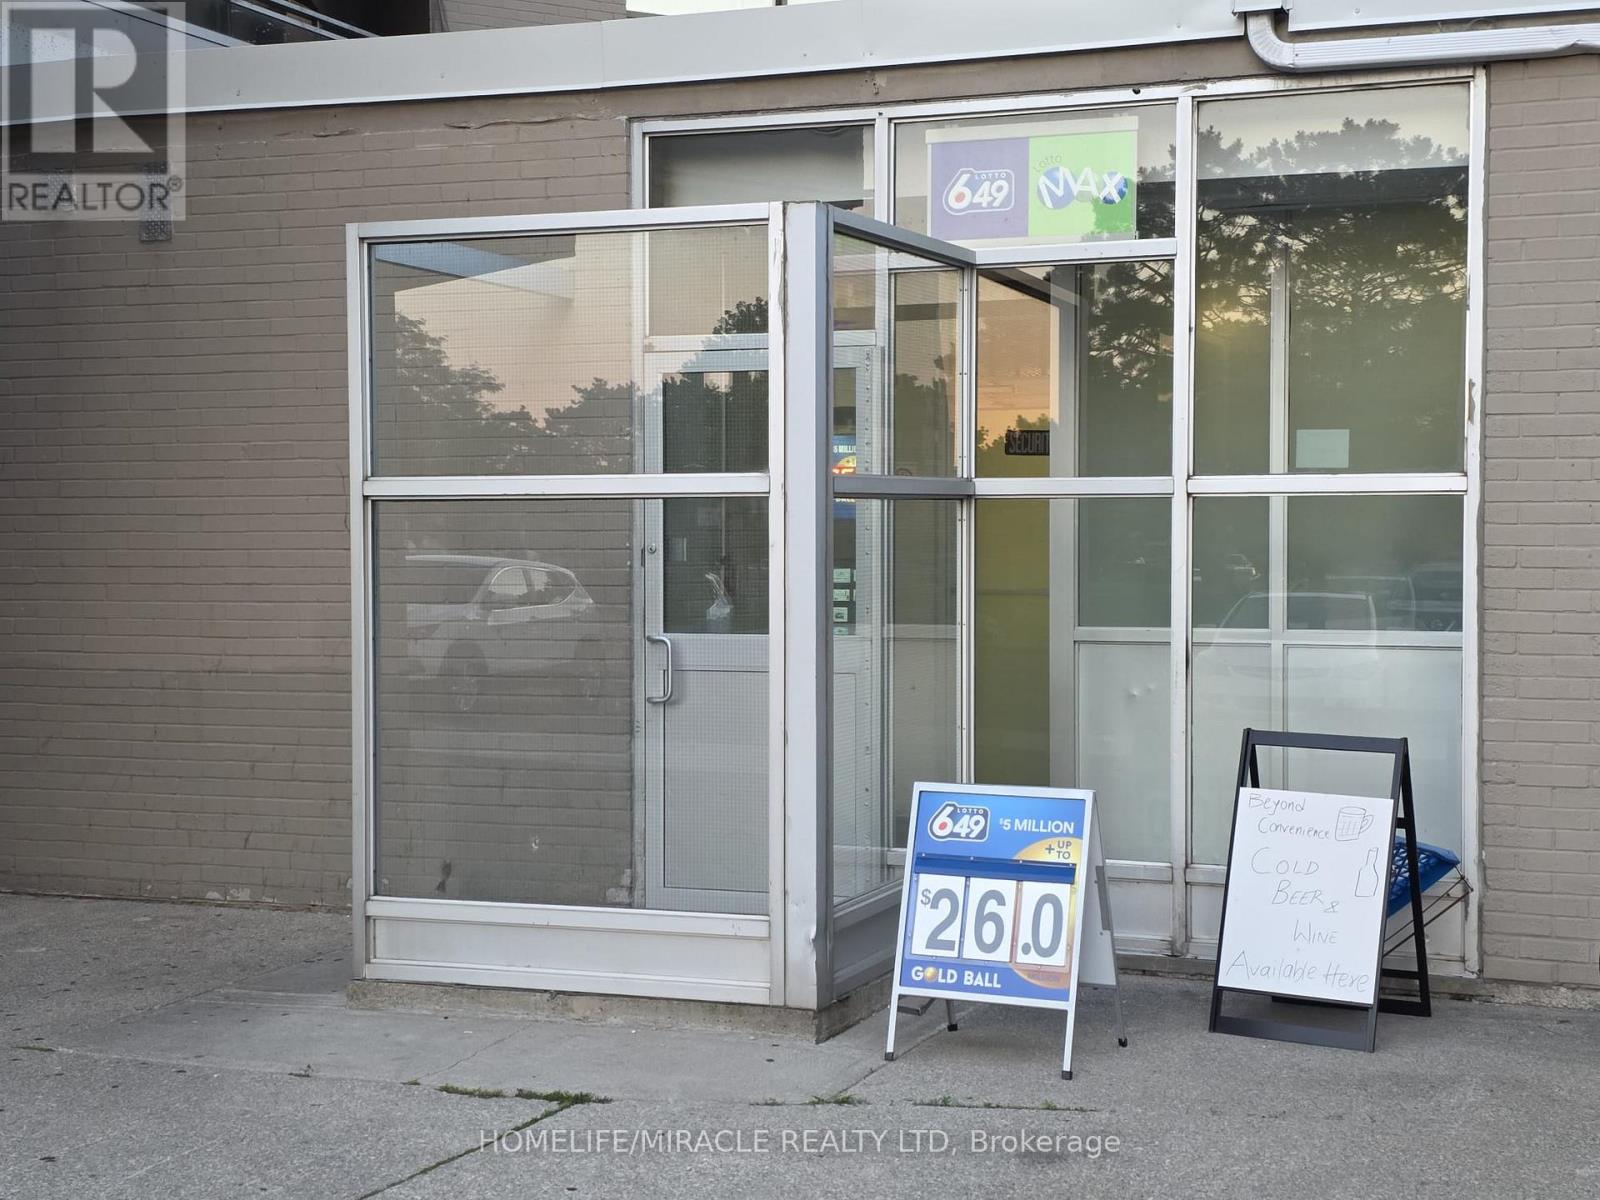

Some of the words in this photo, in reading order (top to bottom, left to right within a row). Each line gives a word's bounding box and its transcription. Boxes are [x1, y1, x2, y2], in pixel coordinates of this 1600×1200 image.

[975, 172, 1007, 180] LOTTO
[949, 173, 1010, 210] 649
[1248, 793, 1306, 815] Beyond
[932, 805, 986, 839] 649
[1014, 819, 1075, 834] MILLION
[1258, 816, 1330, 840] Convenience
[1057, 841, 1072, 850] UP
[1057, 851, 1071, 860] TO
[1251, 847, 1320, 875] COLD
[1271, 879, 1324, 905] BEER
[1323, 900, 1340, 913] &
[1293, 919, 1339, 944] WINE
[911, 966, 958, 984] GOLD
[963, 970, 1002, 988] BALL
[1225, 950, 1319, 981] Available
[1322, 962, 1370, 993] Here
